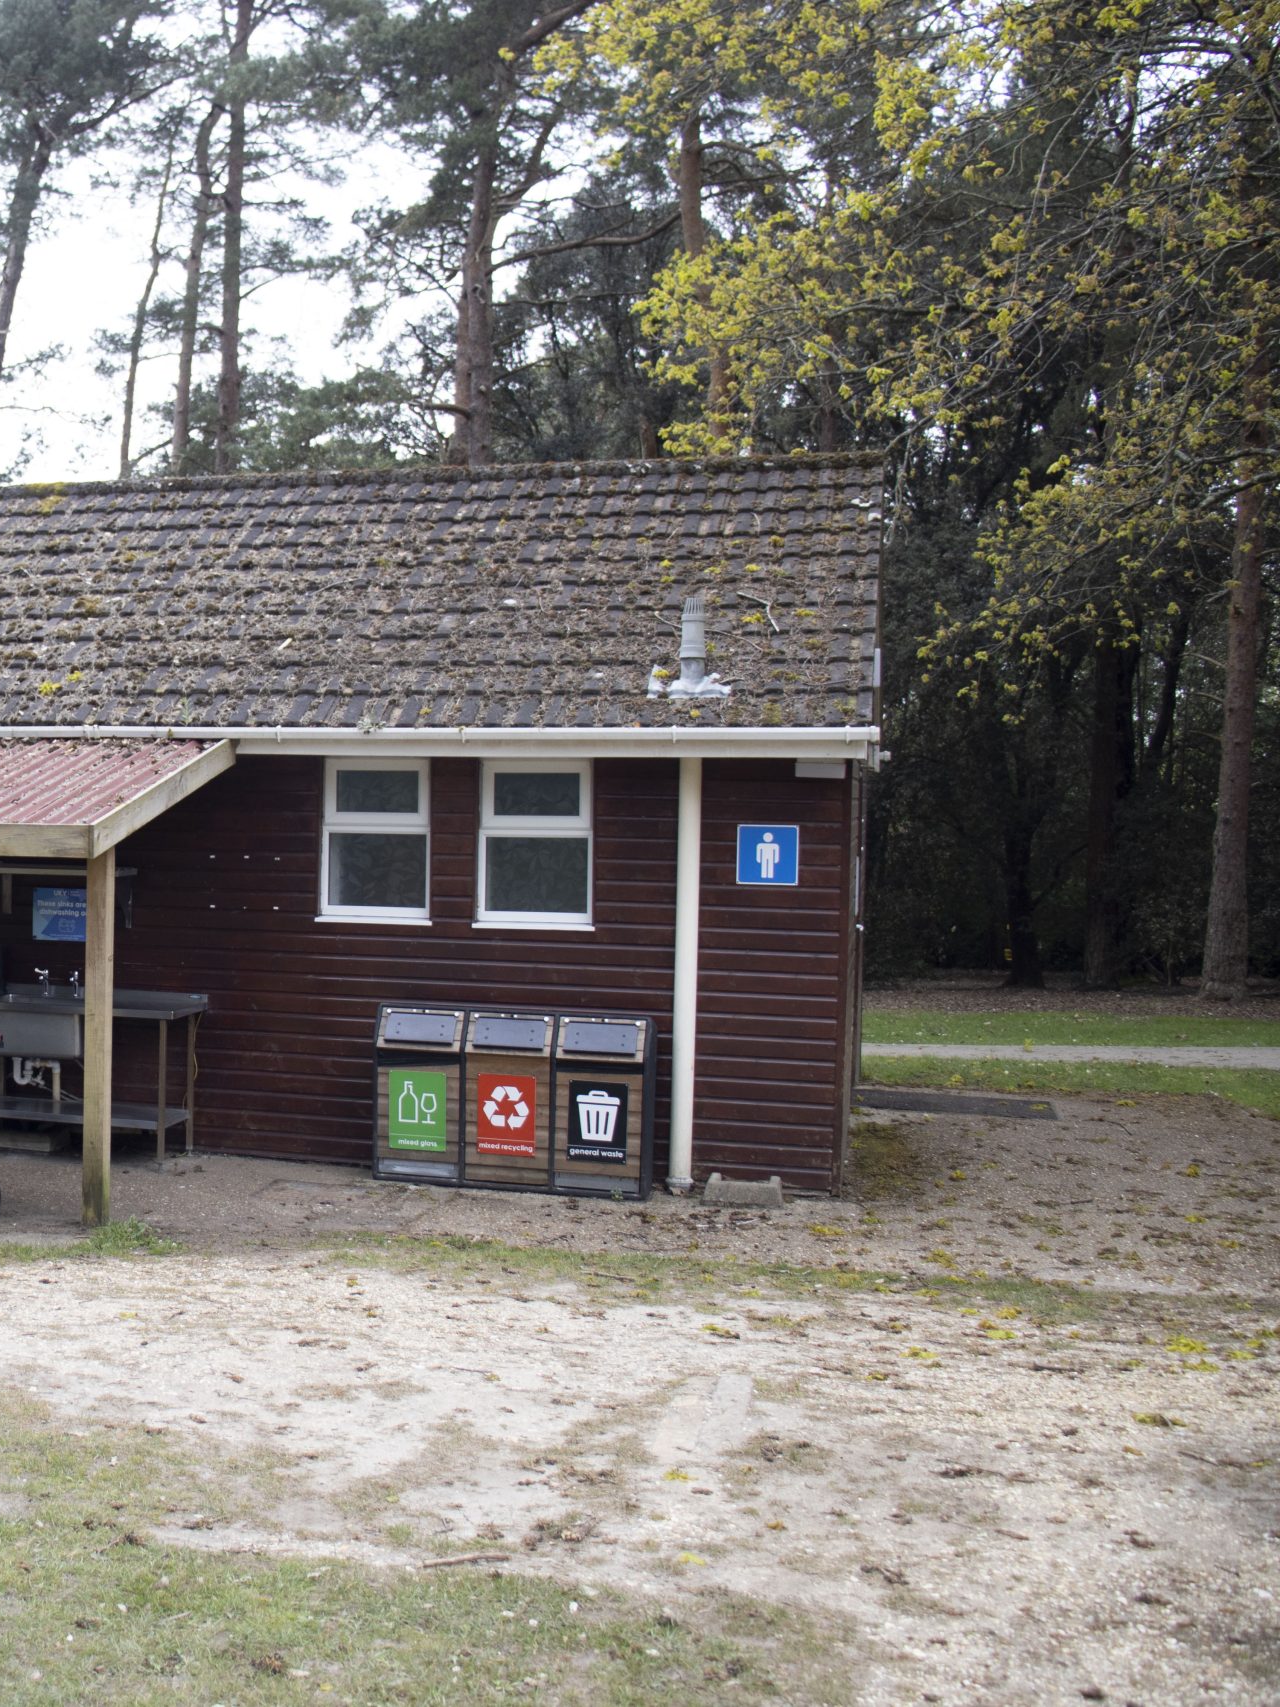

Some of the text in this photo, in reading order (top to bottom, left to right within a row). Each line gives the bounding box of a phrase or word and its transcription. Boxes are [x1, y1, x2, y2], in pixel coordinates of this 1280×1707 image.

[57, 900, 74, 908] sinks
[39, 908, 80, 918] dishwashing
[398, 1138, 438, 1148] mixed glass
[478, 1141, 533, 1153] mixed recycling
[569, 1148, 624, 1158] general waste
